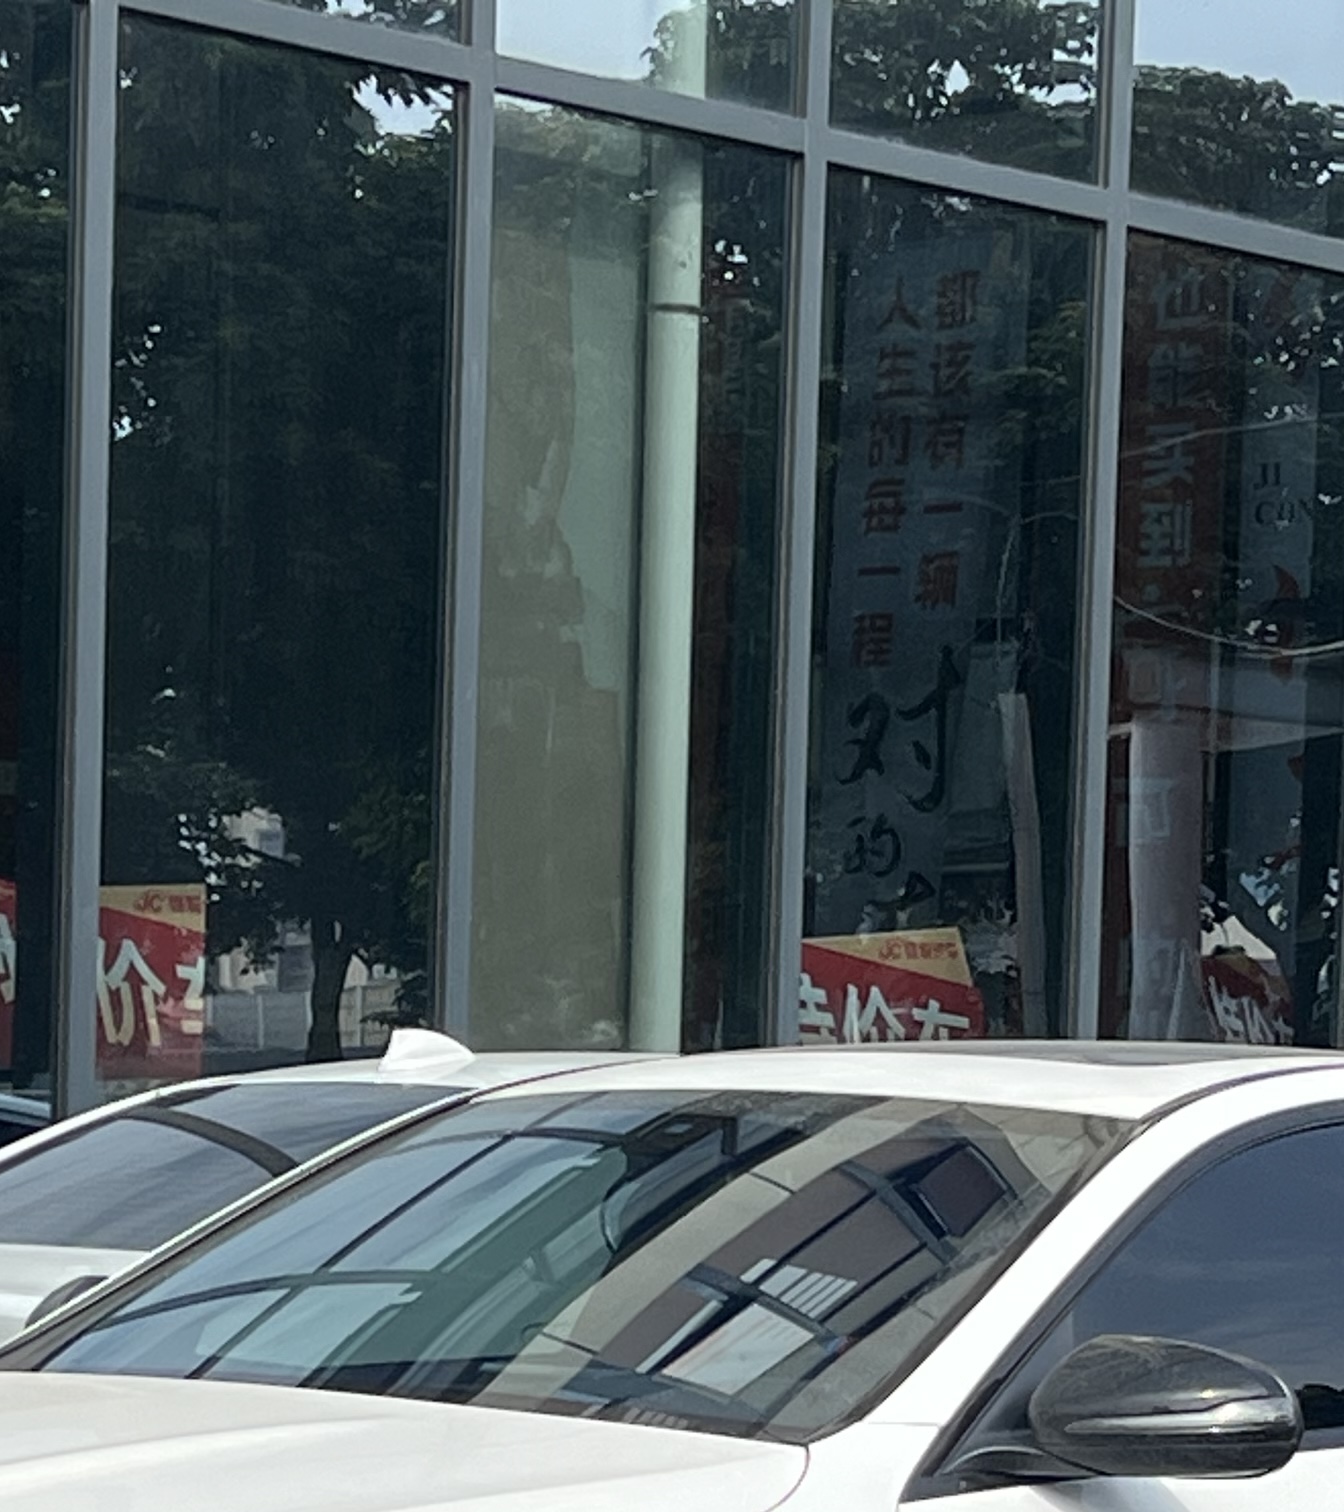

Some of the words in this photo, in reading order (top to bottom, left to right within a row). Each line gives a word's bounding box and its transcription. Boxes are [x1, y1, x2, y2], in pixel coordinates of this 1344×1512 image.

[850, 274, 922, 668] 人生的每一程
